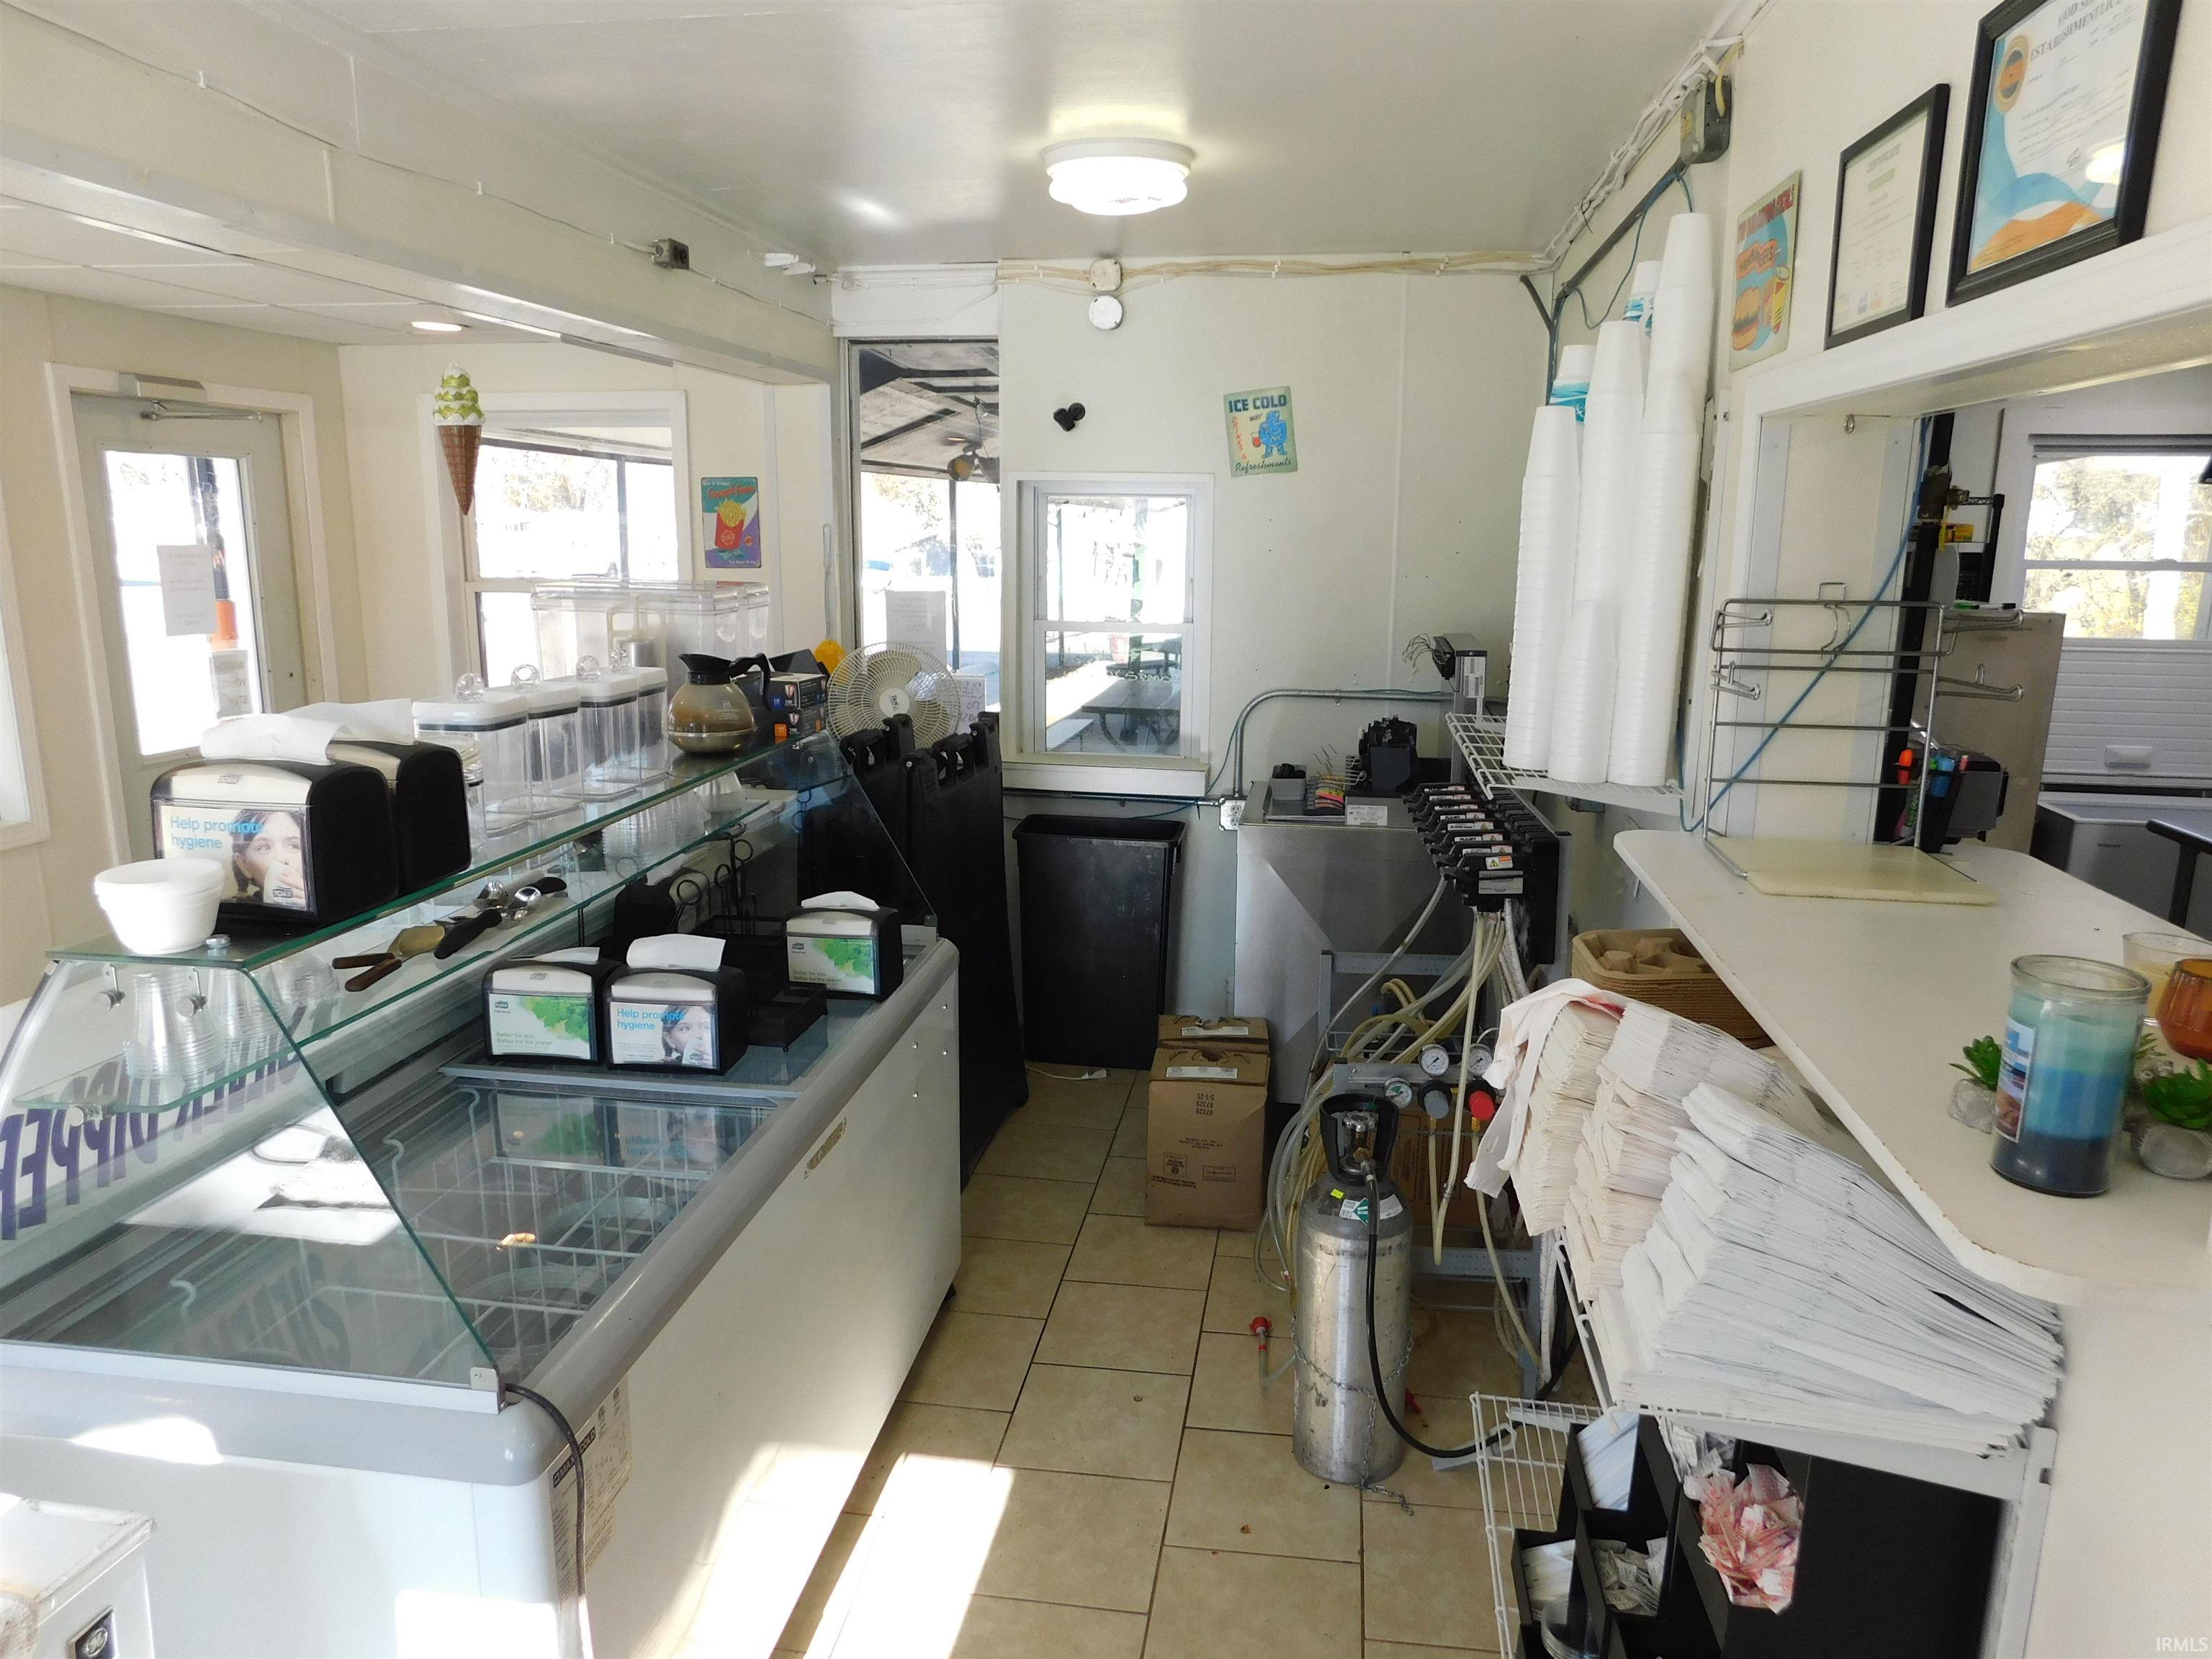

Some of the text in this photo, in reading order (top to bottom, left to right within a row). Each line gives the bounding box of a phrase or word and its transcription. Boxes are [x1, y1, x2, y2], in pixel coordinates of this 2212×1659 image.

[1228, 394, 1287, 413] ICE COLD
[1235, 457, 1292, 474] Refreshments
[170, 816, 264, 837] Help promote
[171, 834, 223, 851] hygiene
[616, 1008, 685, 1021] Help promote
[617, 1019, 656, 1032] hygiene
